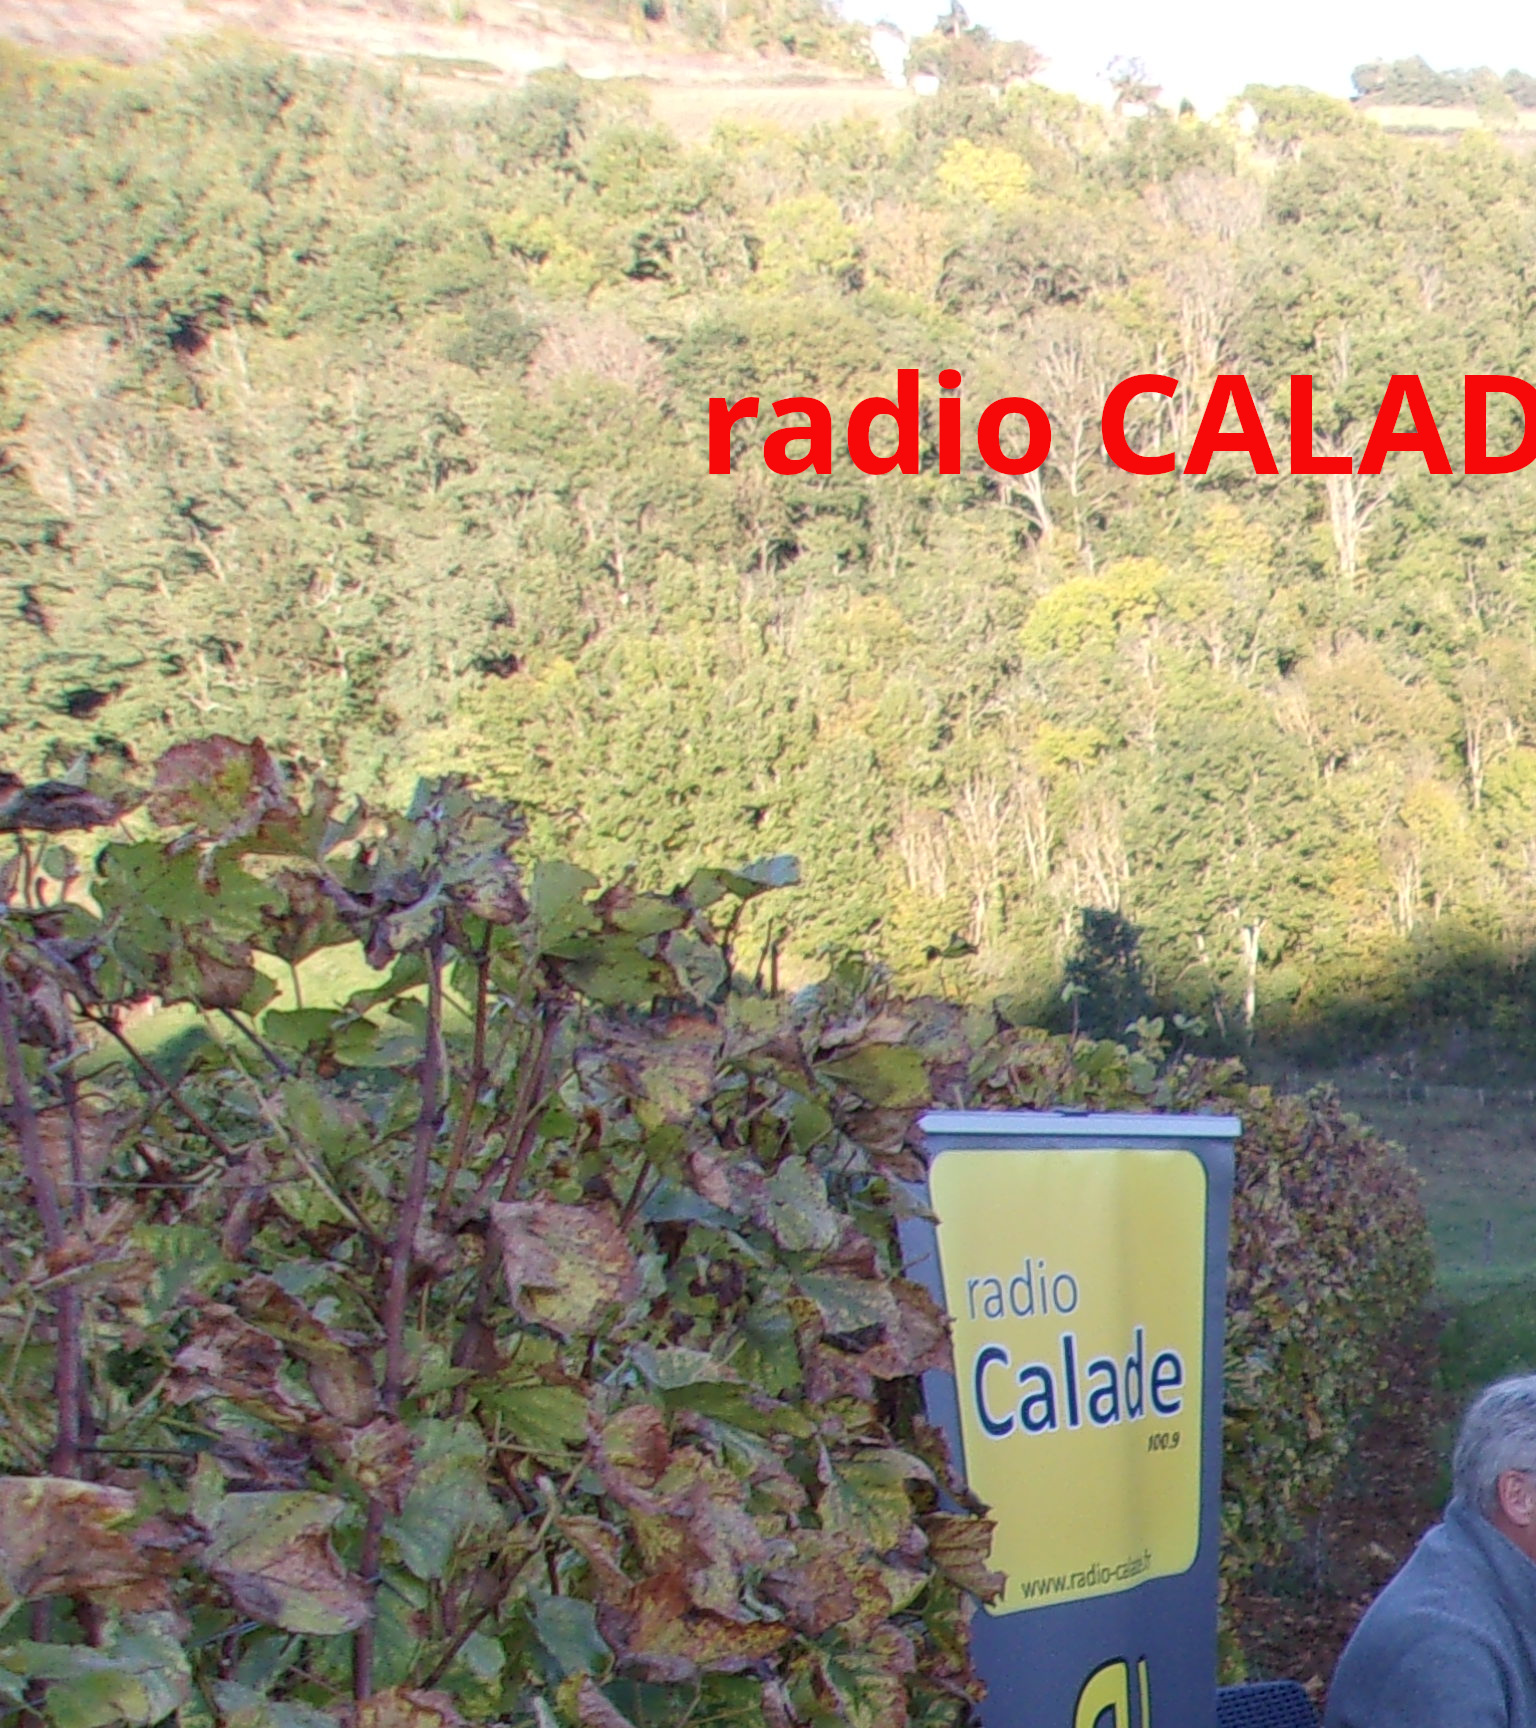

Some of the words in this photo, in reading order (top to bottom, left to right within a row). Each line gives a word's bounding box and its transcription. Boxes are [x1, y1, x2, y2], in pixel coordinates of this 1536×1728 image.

[967, 1259, 1078, 1319] radio
[974, 1328, 1183, 1436] Calade
[1147, 1431, 1180, 1452] 100.9
